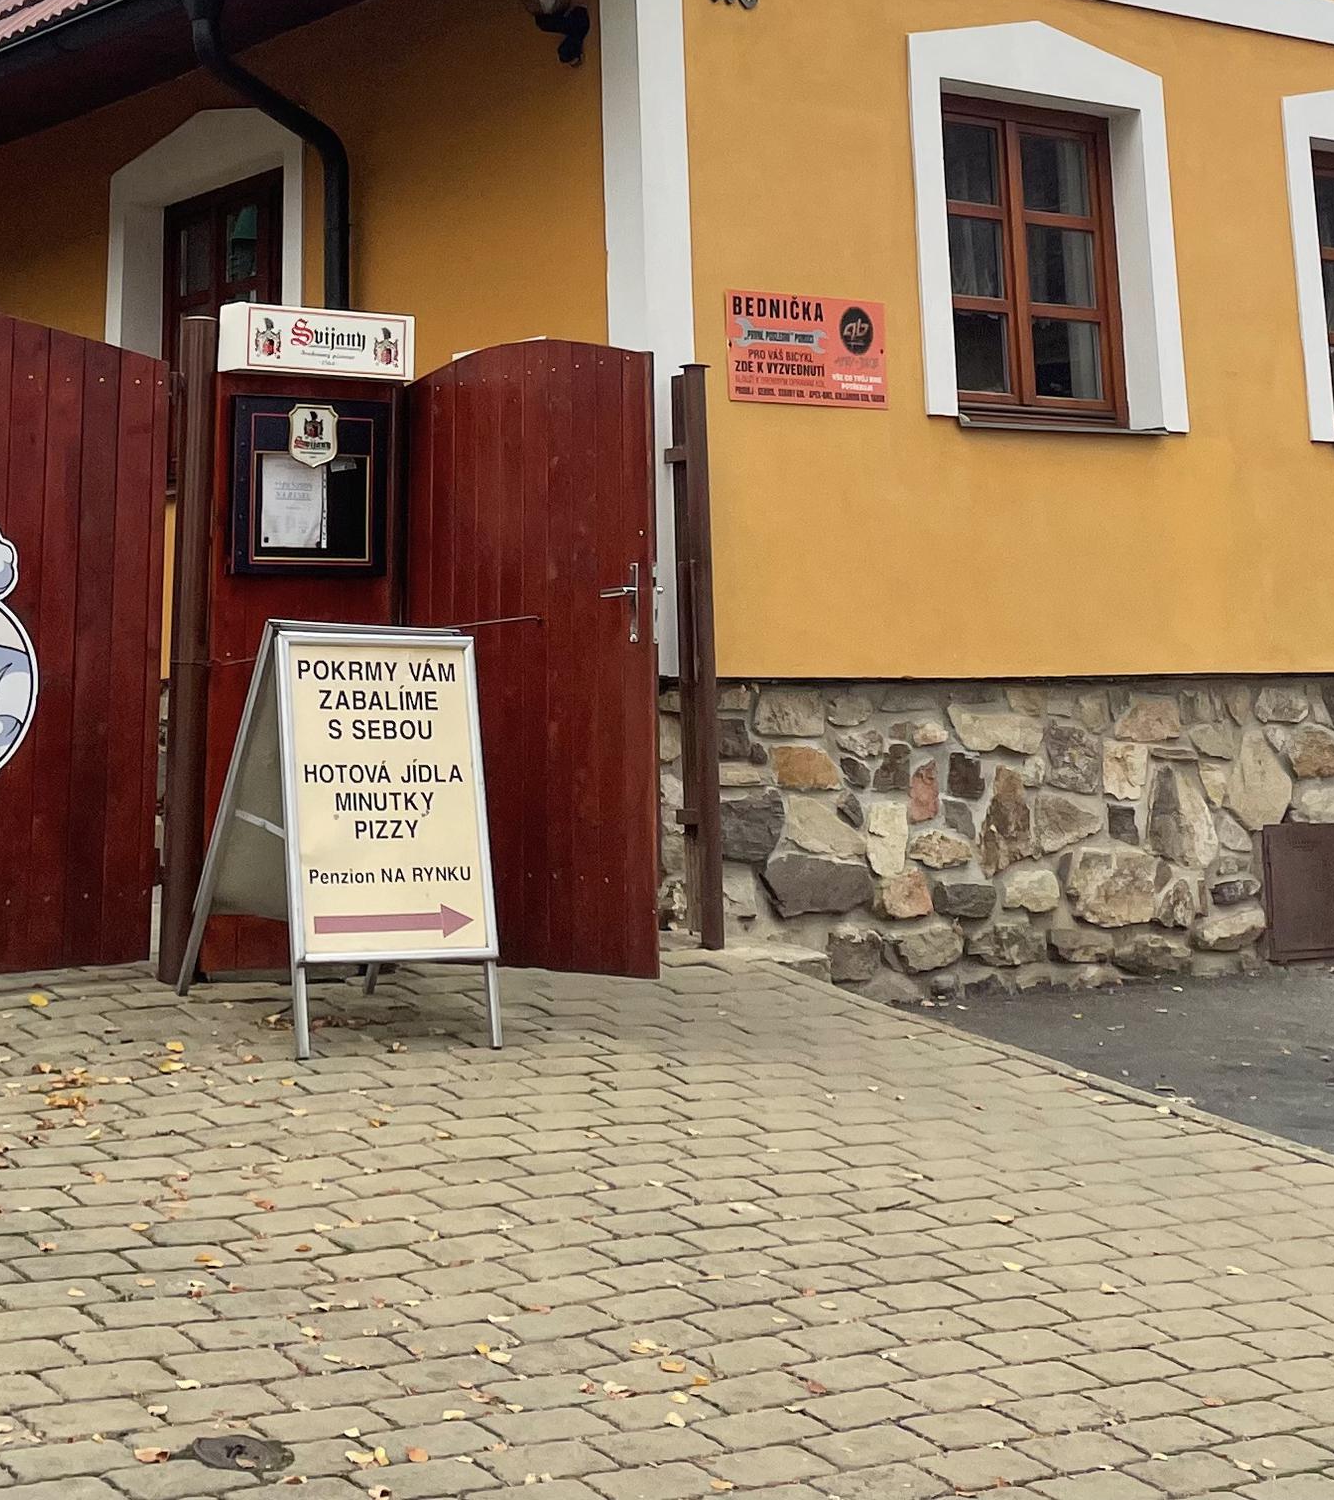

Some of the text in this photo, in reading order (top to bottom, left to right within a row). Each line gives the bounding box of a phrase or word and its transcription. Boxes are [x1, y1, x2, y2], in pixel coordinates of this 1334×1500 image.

[733, 295, 824, 322] BEDNIČKA
[291, 318, 366, 352] Svijany
[748, 347, 814, 363] PRO VÁŠ BICYKL
[735, 360, 755, 373] ZDE
[757, 362, 764, 373] K
[767, 362, 825, 377] VYZVEDNUTÍ
[297, 658, 456, 682] POKRMY VÁM
[319, 685, 438, 710] ZABALÍME
[328, 719, 432, 739] S SEBOU
[304, 759, 463, 783] HOTOVÁ JÍDLA
[335, 792, 434, 811] MINUTKY
[355, 820, 418, 839] PIZZY
[309, 866, 471, 884] Penzion NA RYNKU
